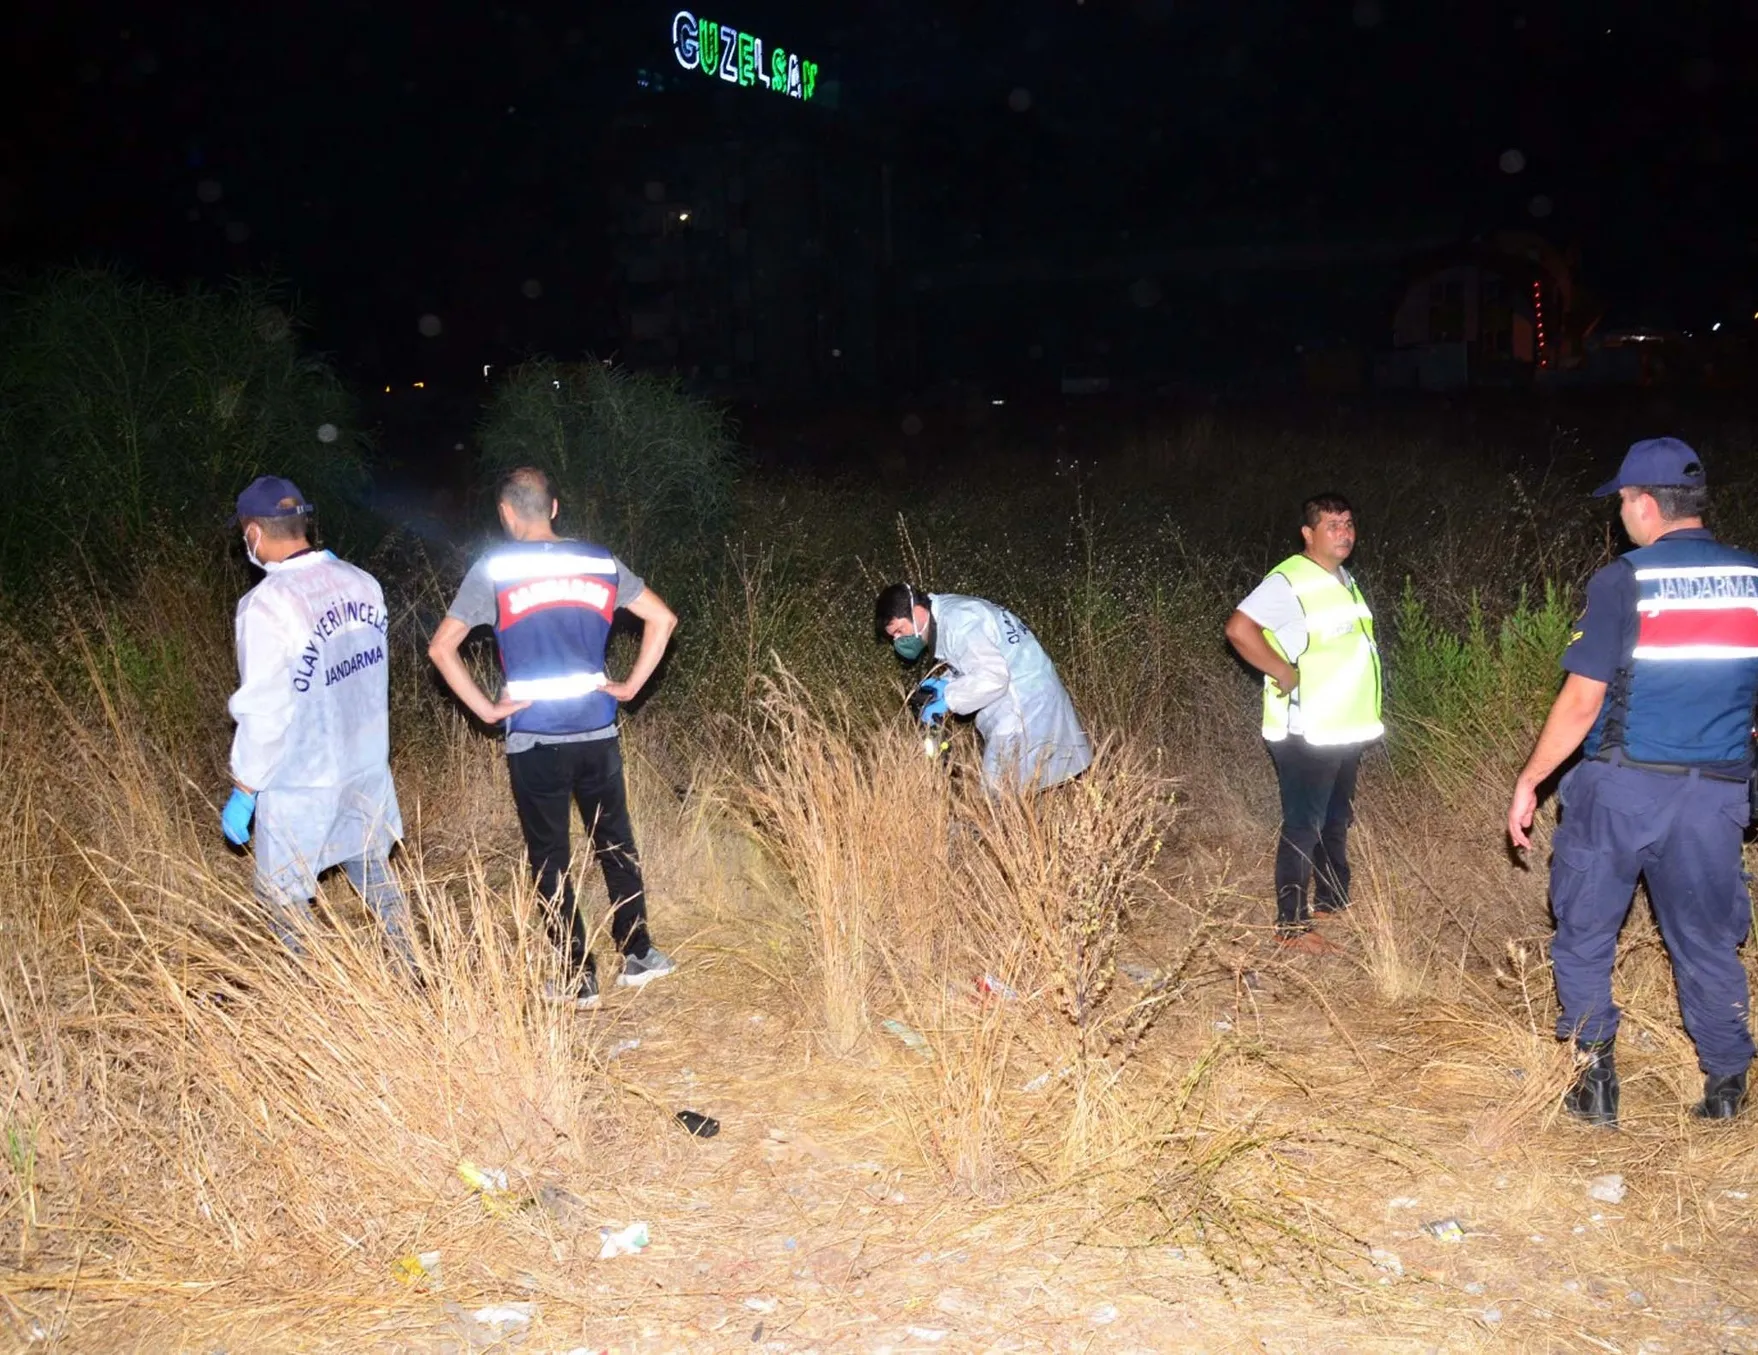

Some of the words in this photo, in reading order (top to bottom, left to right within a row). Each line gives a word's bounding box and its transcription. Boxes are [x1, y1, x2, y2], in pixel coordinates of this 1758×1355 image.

[1654, 574, 1758, 600] JANDARMA
[293, 639, 320, 692] OLAY
[313, 601, 343, 643] YERİ
[325, 645, 384, 686] JANDARMA
